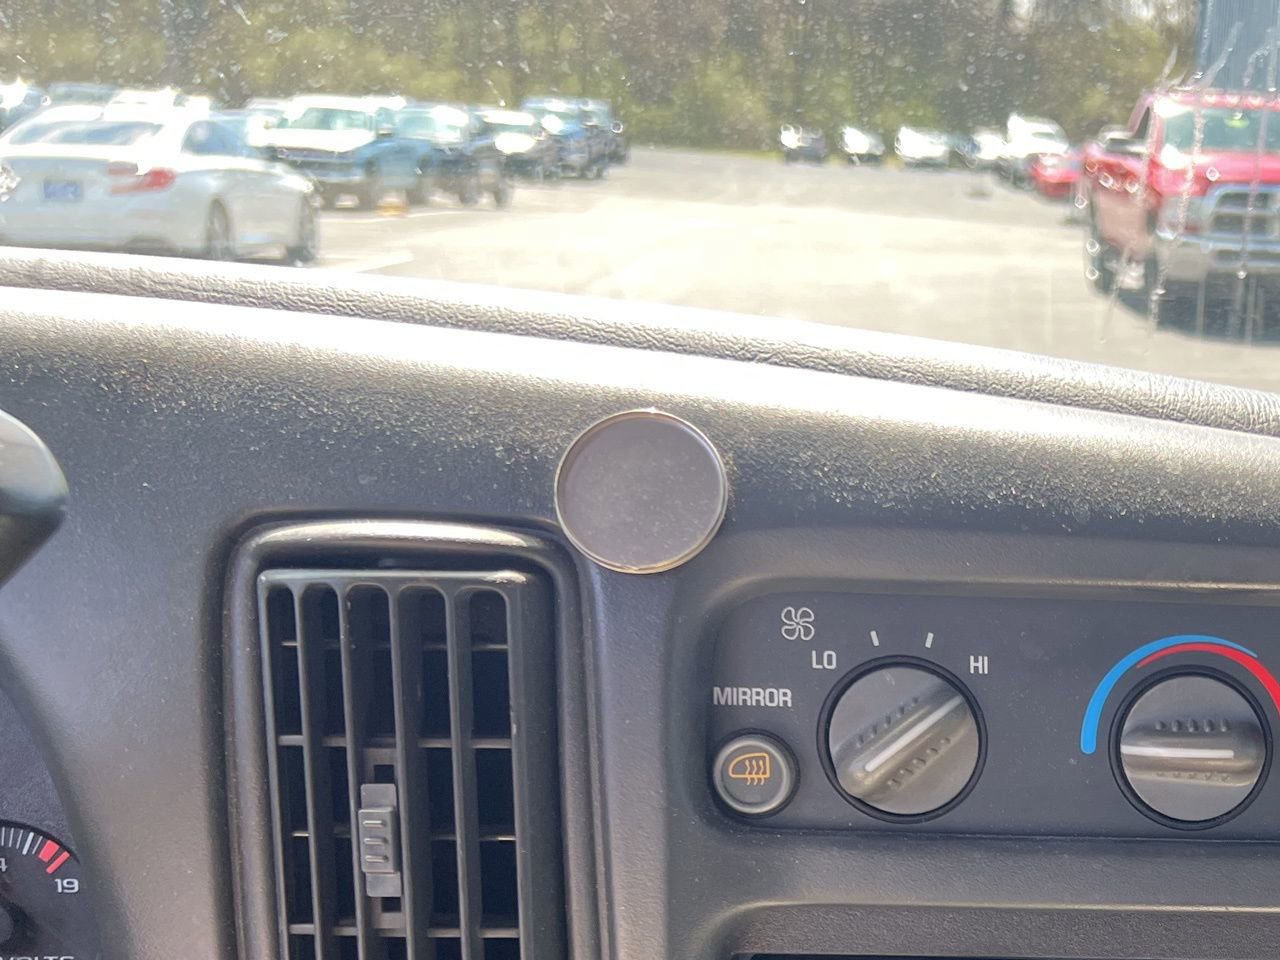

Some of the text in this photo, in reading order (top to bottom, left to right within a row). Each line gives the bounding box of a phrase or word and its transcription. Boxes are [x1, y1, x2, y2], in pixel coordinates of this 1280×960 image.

[812, 650, 837, 670] LO
[969, 655, 989, 675] HI
[712, 686, 792, 708] MIRROR
[54, 878, 80, 893] 19
